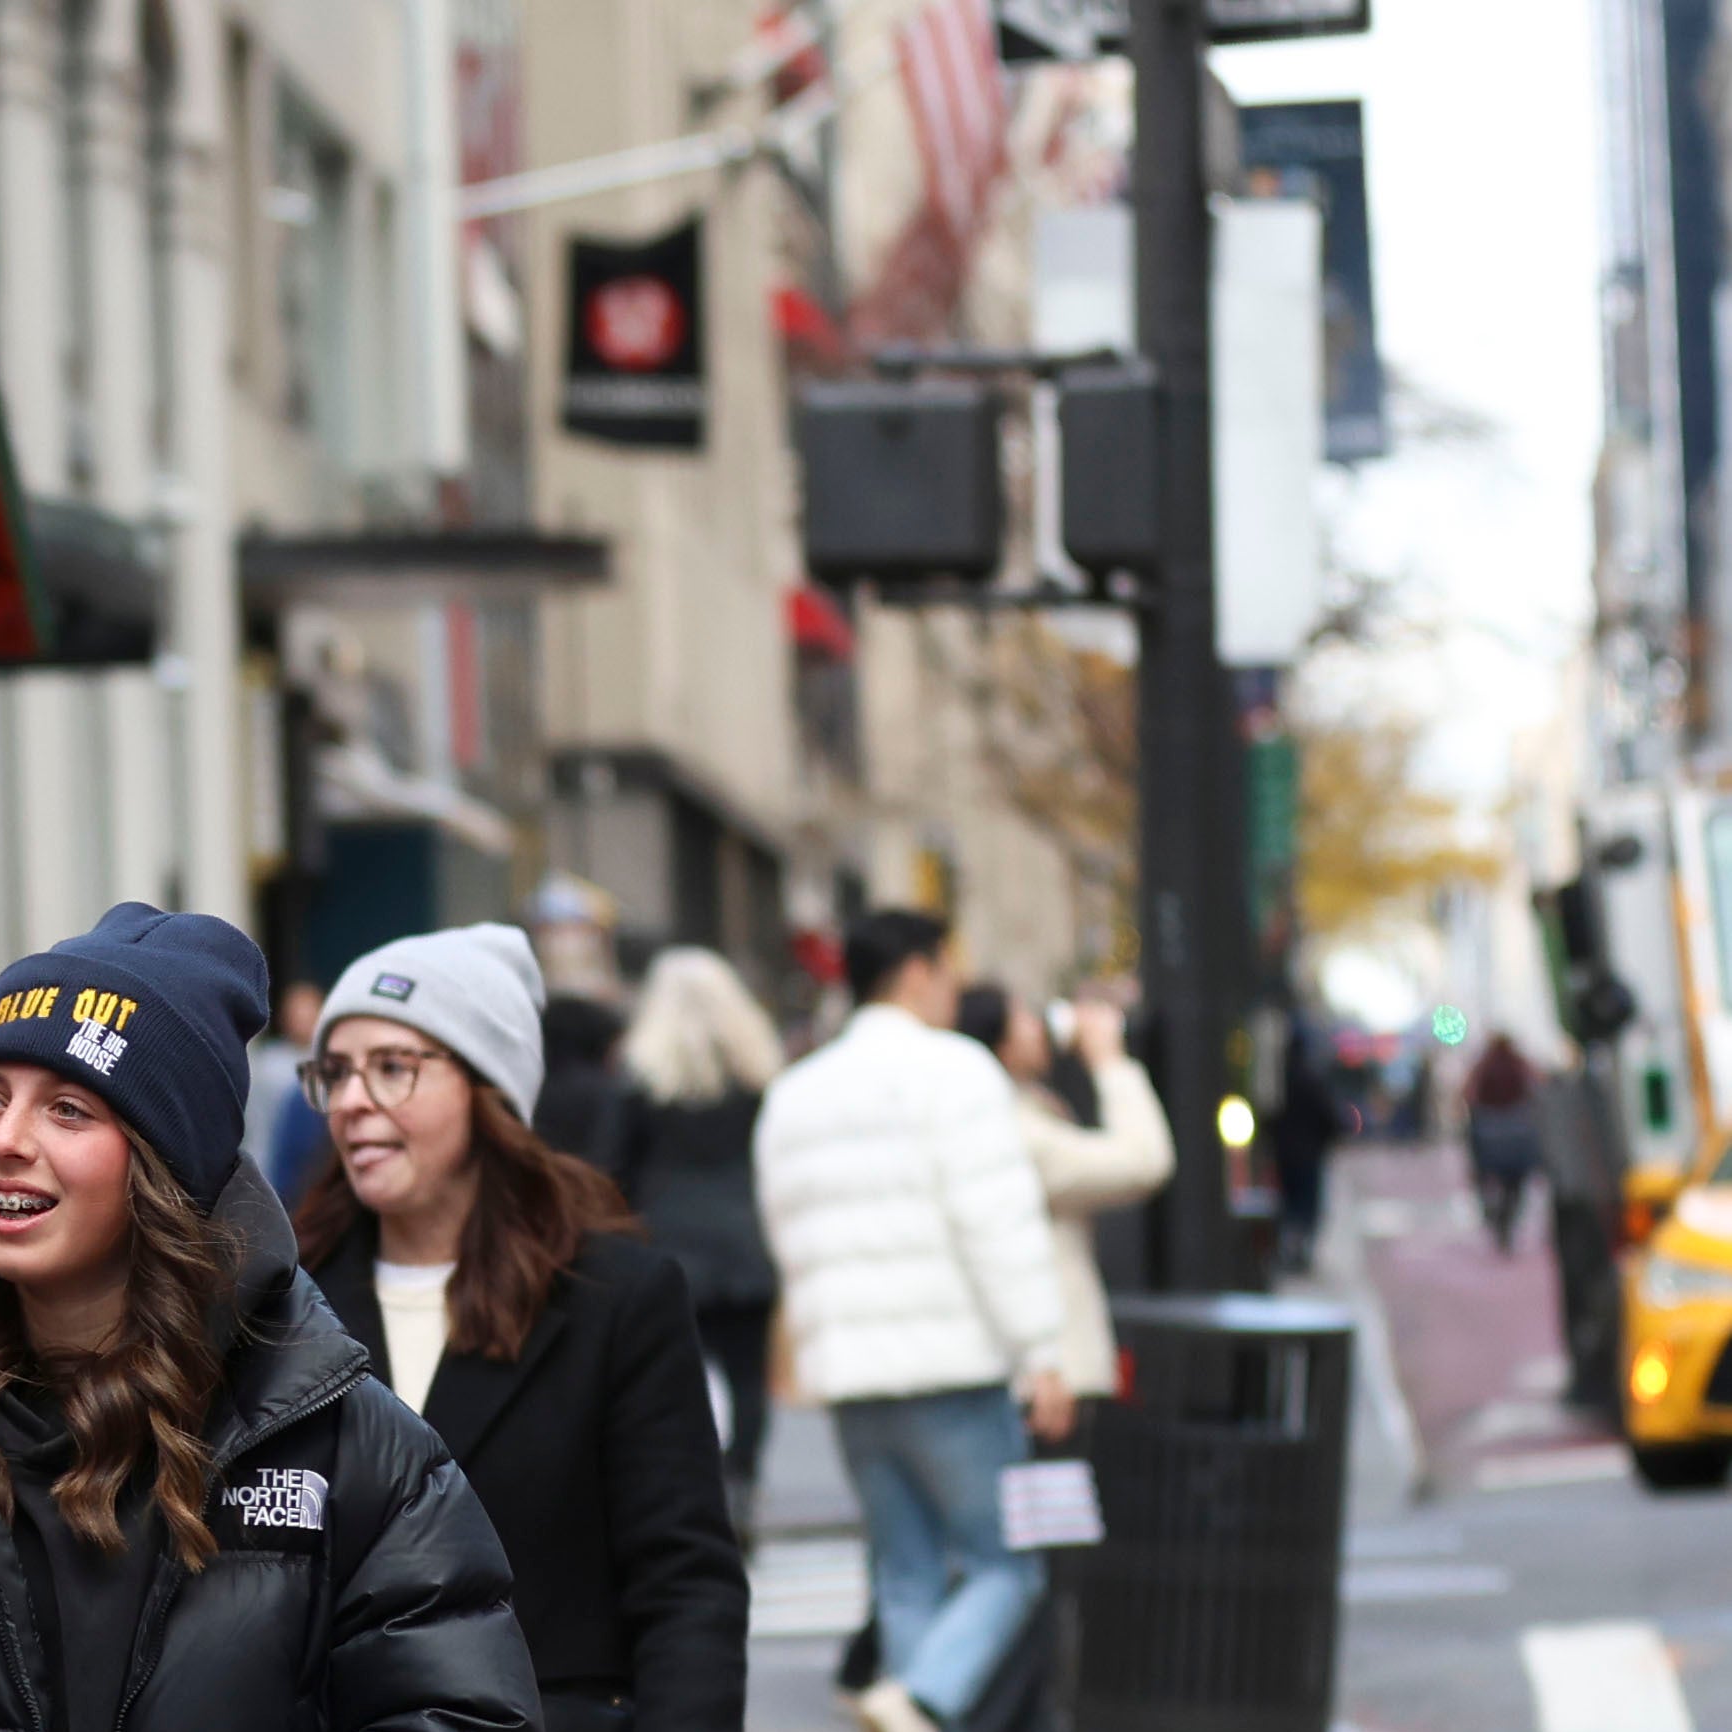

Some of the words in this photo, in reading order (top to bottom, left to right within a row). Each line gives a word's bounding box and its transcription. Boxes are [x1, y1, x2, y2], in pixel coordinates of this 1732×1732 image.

[72, 988, 137, 1031] OUT
[78, 1017, 107, 1043] THE
[102, 1031, 128, 1057] BIG
[65, 1033, 119, 1076] HOUSE
[256, 1468, 302, 1488] THE
[221, 1486, 301, 1508] NORTH
[243, 1506, 301, 1527] FACE
